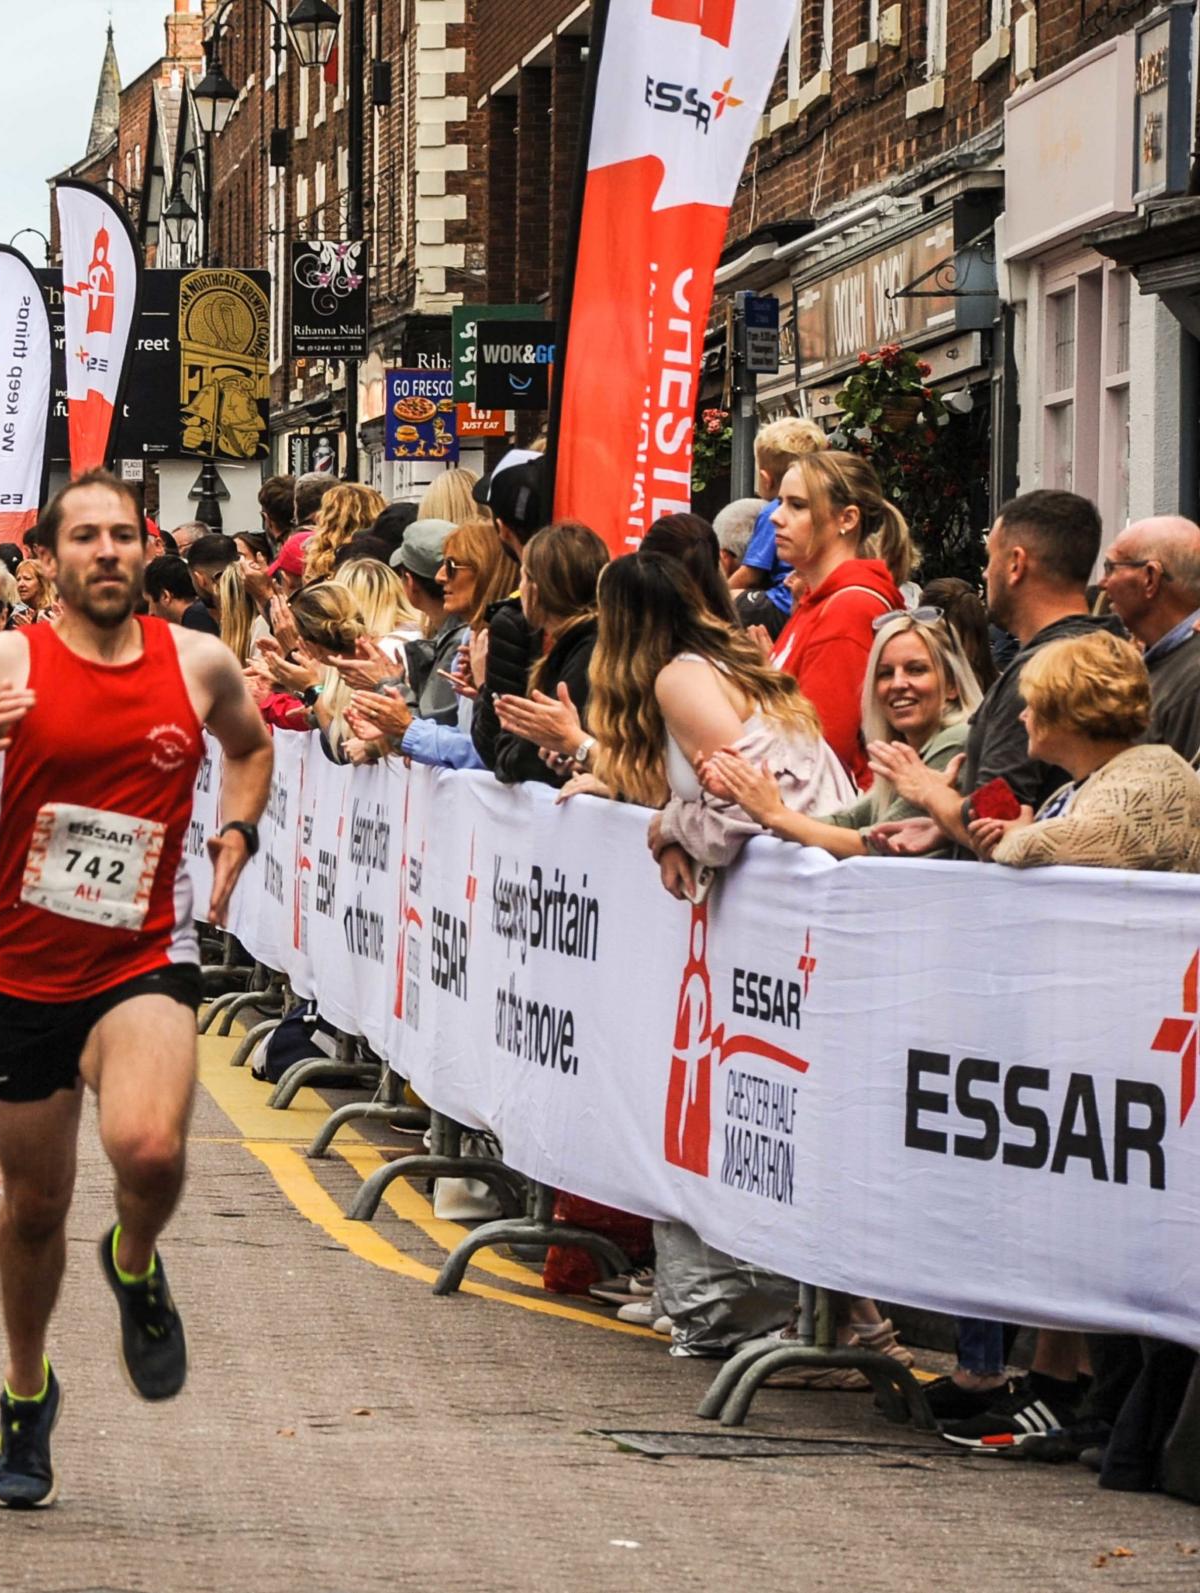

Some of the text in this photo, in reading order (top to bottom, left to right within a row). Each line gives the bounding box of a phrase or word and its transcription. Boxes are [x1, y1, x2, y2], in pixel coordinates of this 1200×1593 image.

[186, 273, 241, 296] NORTHGATE
[240, 282, 269, 322] BREWERY
[294, 324, 365, 335] Rihanna Nails
[394, 380, 453, 396] GO FRESCO
[462, 422, 500, 430] JUST EAT
[68, 821, 133, 846] ESSAR
[65, 849, 125, 885] 742
[74, 883, 102, 901] ALI
[529, 865, 600, 962] Britain
[431, 906, 468, 1001] ESSAR
[732, 967, 801, 1030] ESSAR
[524, 999, 579, 1076] move.
[726, 1069, 798, 1135] CHESTER HALF
[905, 1048, 1166, 1190] ESSAR
[721, 1123, 795, 1206] MARATHON
